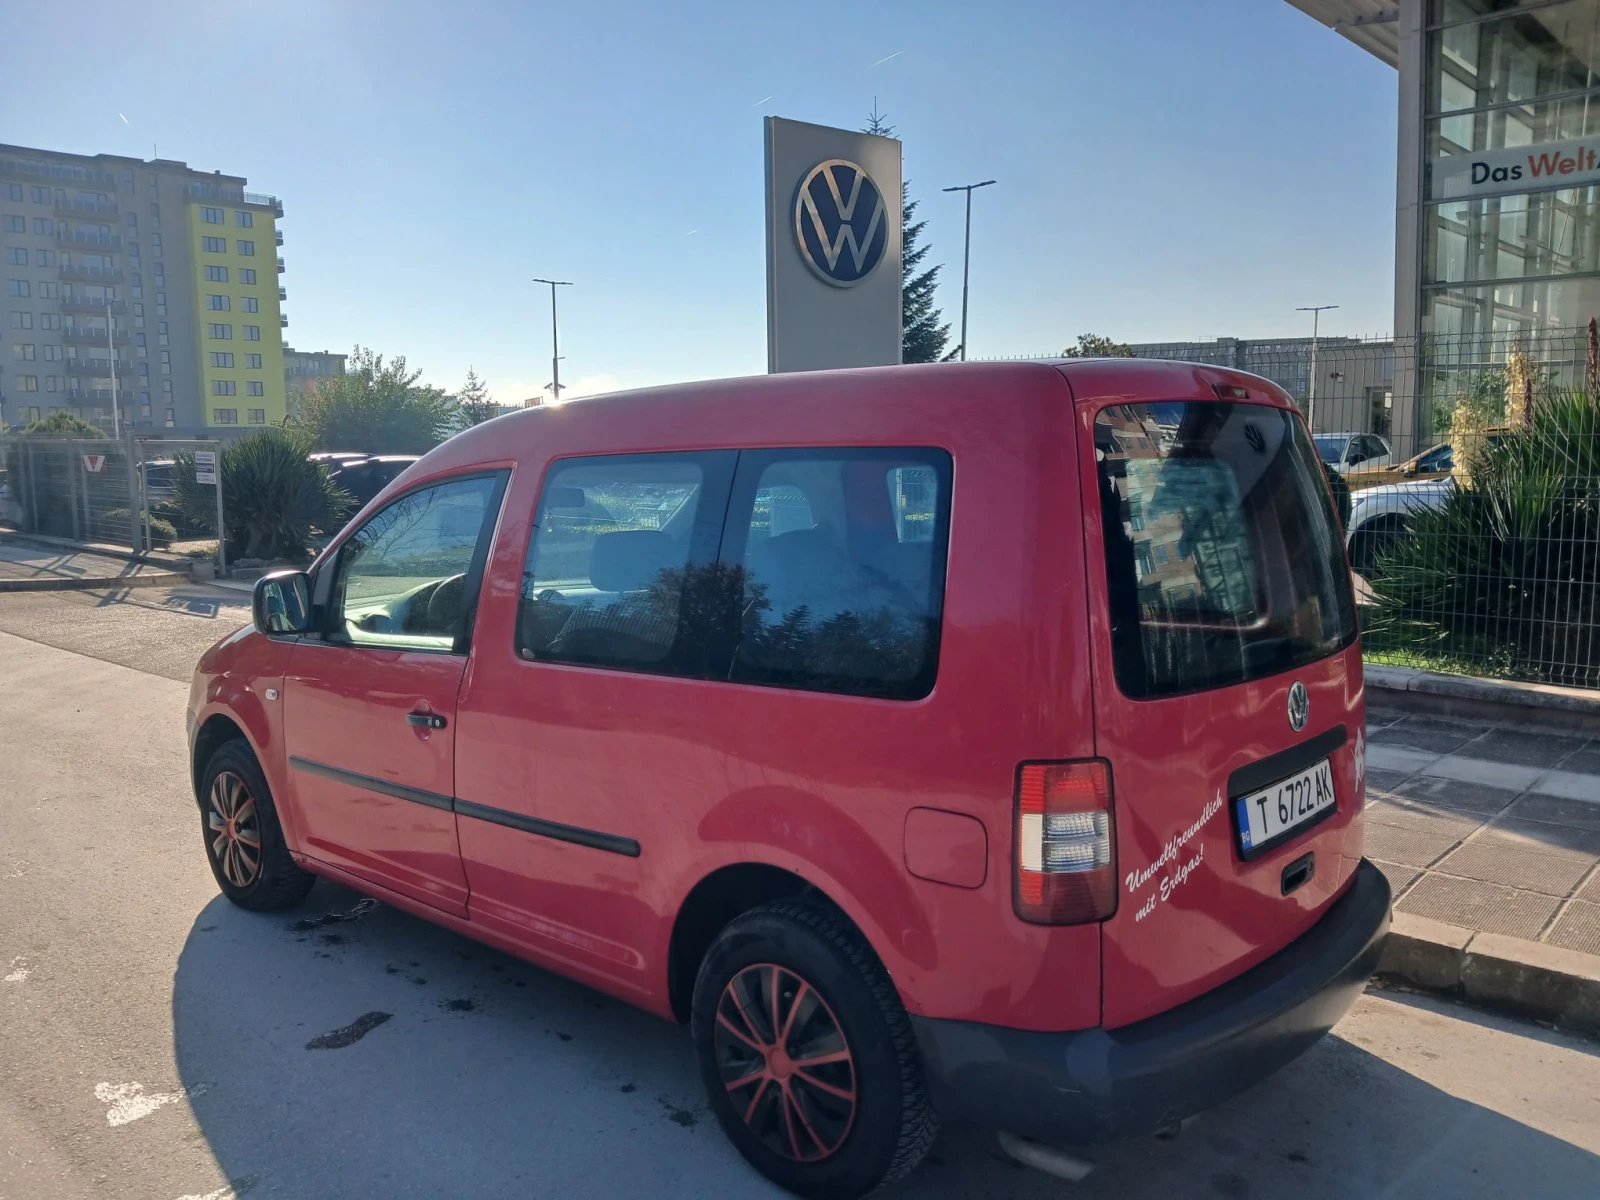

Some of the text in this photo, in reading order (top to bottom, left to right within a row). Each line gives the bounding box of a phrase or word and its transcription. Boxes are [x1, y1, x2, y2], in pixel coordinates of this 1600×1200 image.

[1471, 146, 1600, 185] Das Welt
[1256, 765, 1332, 834] T 6722 AK
[1125, 787, 1223, 892] Umweltfreundlich
[1241, 830, 1251, 844] BG
[1135, 843, 1204, 922] mit Erdgas!
